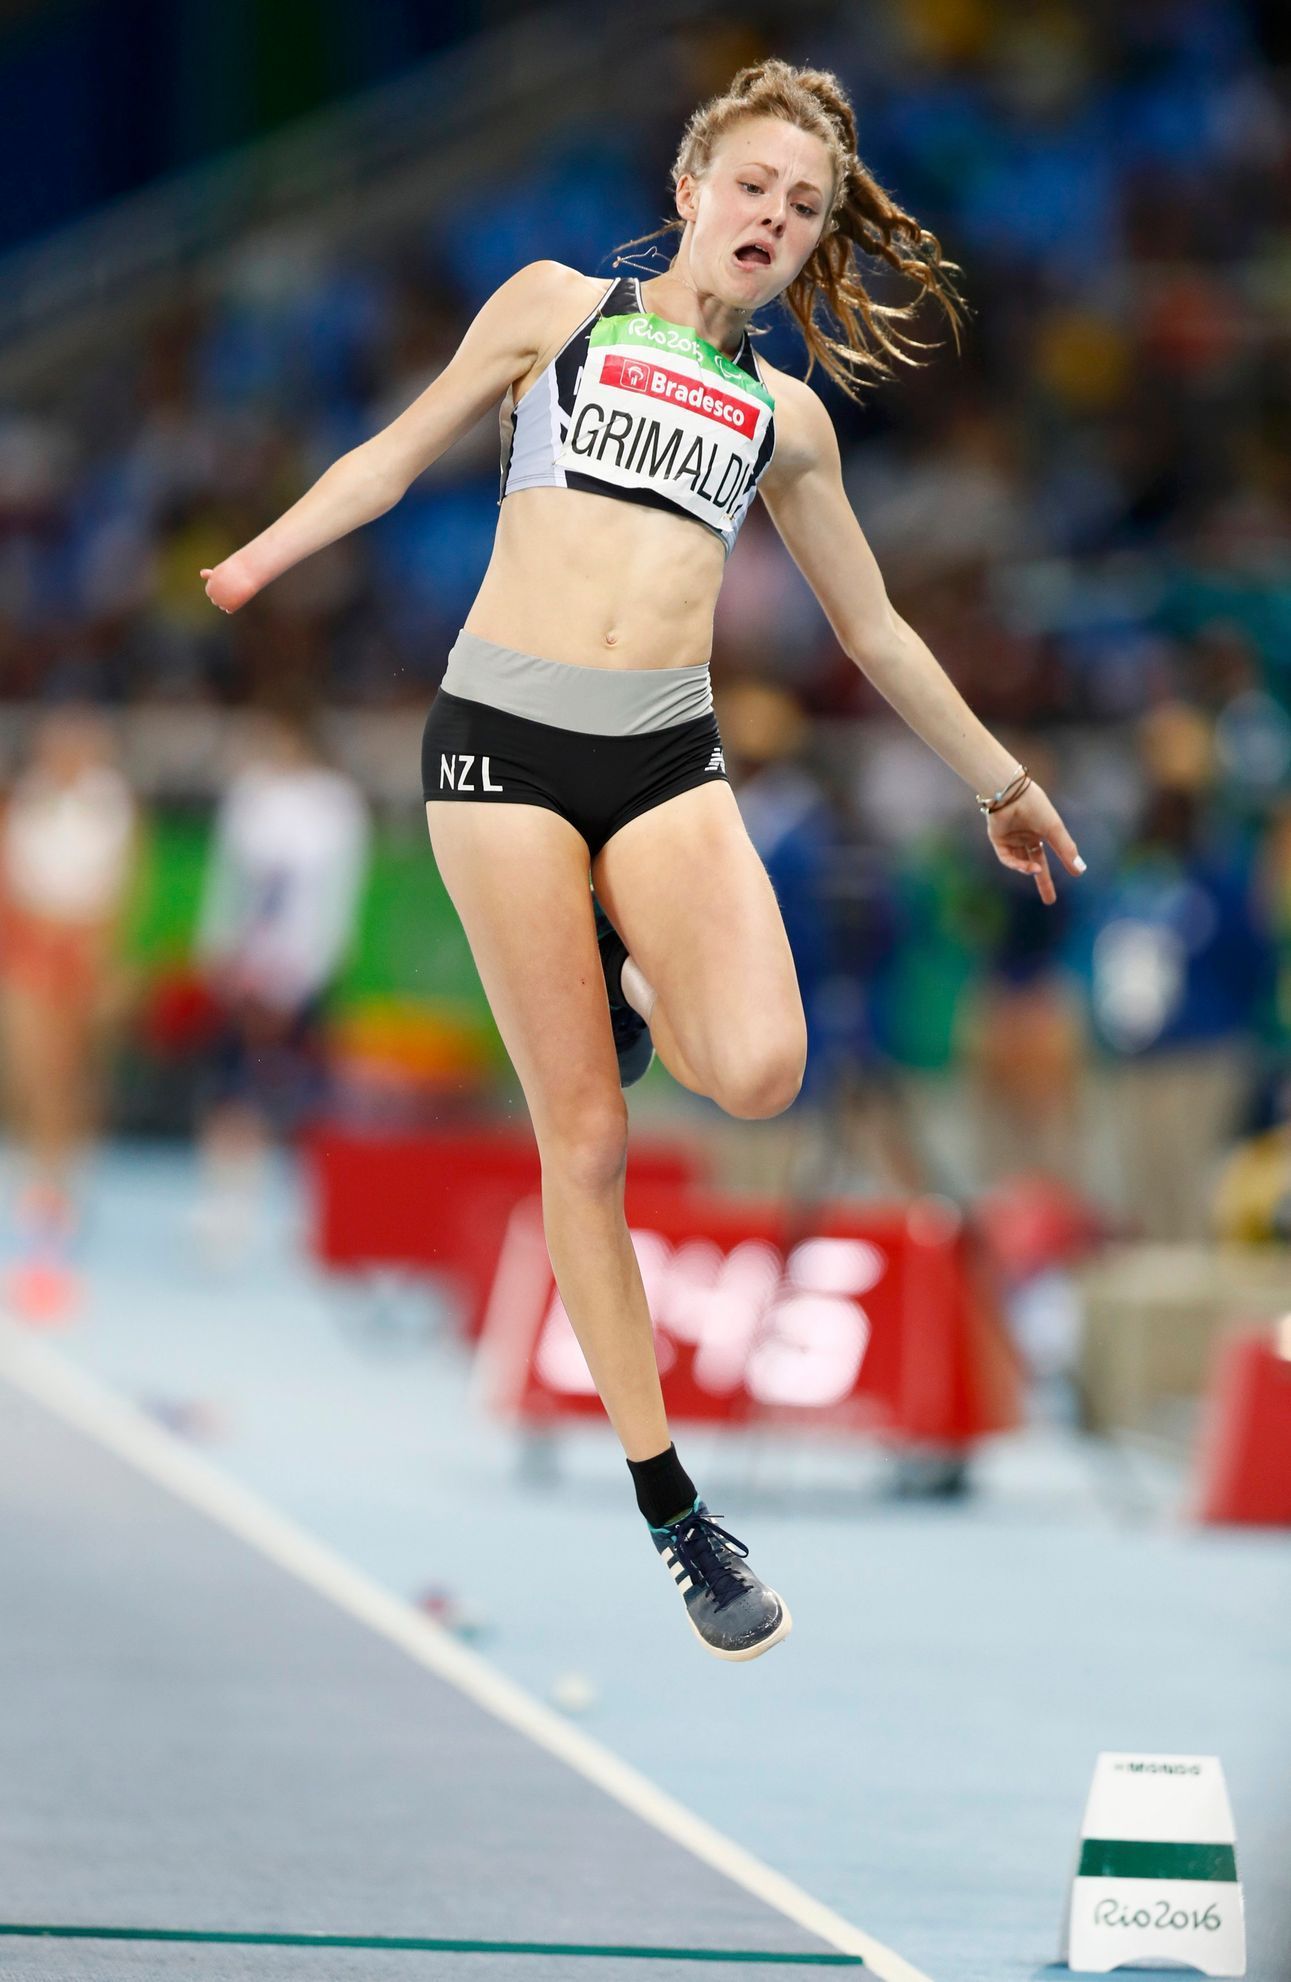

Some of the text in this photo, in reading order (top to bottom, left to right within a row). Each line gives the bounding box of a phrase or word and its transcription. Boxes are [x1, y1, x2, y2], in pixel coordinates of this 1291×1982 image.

[650, 371, 745, 427] Bradesco
[571, 402, 750, 514] GRIMALDI
[439, 753, 504, 792] NZL
[1094, 1898, 1222, 1931] Rio2016
